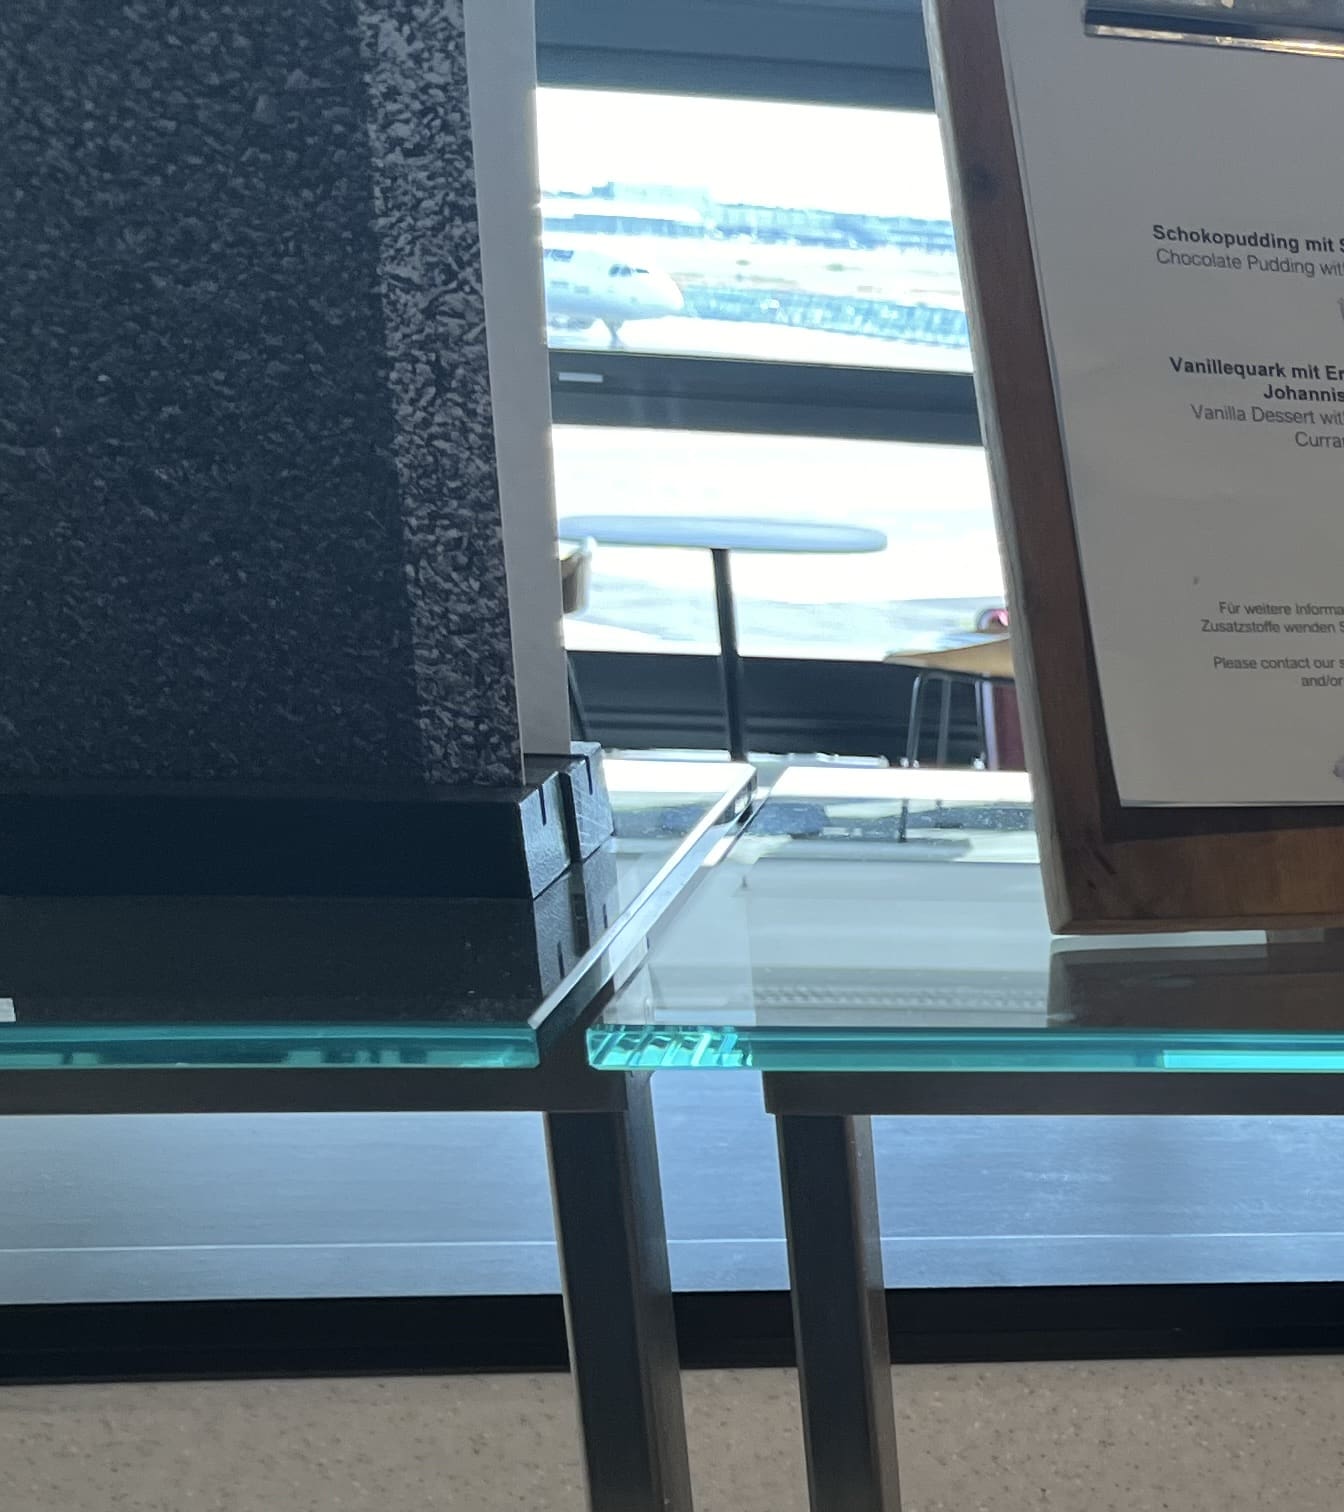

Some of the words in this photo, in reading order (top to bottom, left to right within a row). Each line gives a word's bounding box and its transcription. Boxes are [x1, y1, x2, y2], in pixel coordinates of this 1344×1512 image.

[1152, 224, 1300, 253] Schokopudding
[1305, 237, 1335, 253] mit
[1155, 248, 1242, 270] Chocolate
[1247, 255, 1315, 278] Pudding
[1169, 356, 1287, 379] Vanillequark
[1291, 364, 1321, 380] mit
[1191, 403, 1247, 421] Vanilla
[1251, 406, 1316, 425] Dessert
[1218, 601, 1241, 615] Für
[1243, 603, 1292, 616] weitere
[1200, 619, 1280, 633] Zusatzstoffe
[1284, 622, 1336, 634] wenden
[1213, 656, 1257, 669] Please
[1260, 657, 1311, 670] contact
[1313, 658, 1334, 669] our
[1301, 674, 1343, 688] and/or
